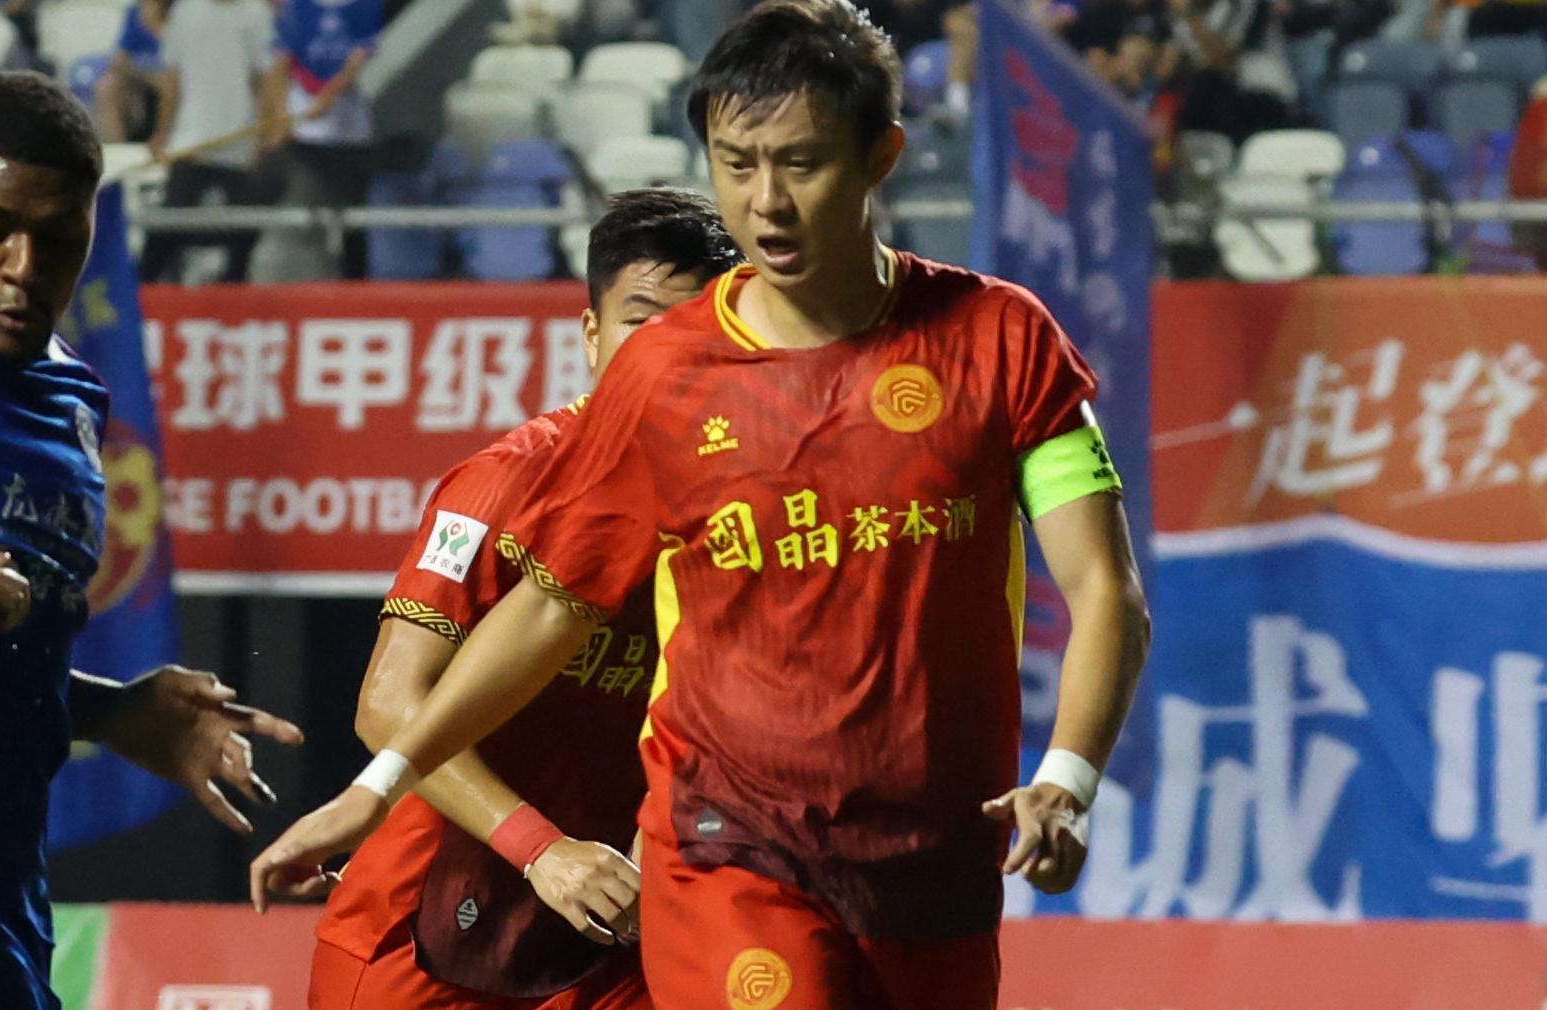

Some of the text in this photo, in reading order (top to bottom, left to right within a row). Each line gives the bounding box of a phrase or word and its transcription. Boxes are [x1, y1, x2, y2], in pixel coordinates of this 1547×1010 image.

[142, 316, 594, 432] 球甲级
[698, 438, 739, 456] KELME
